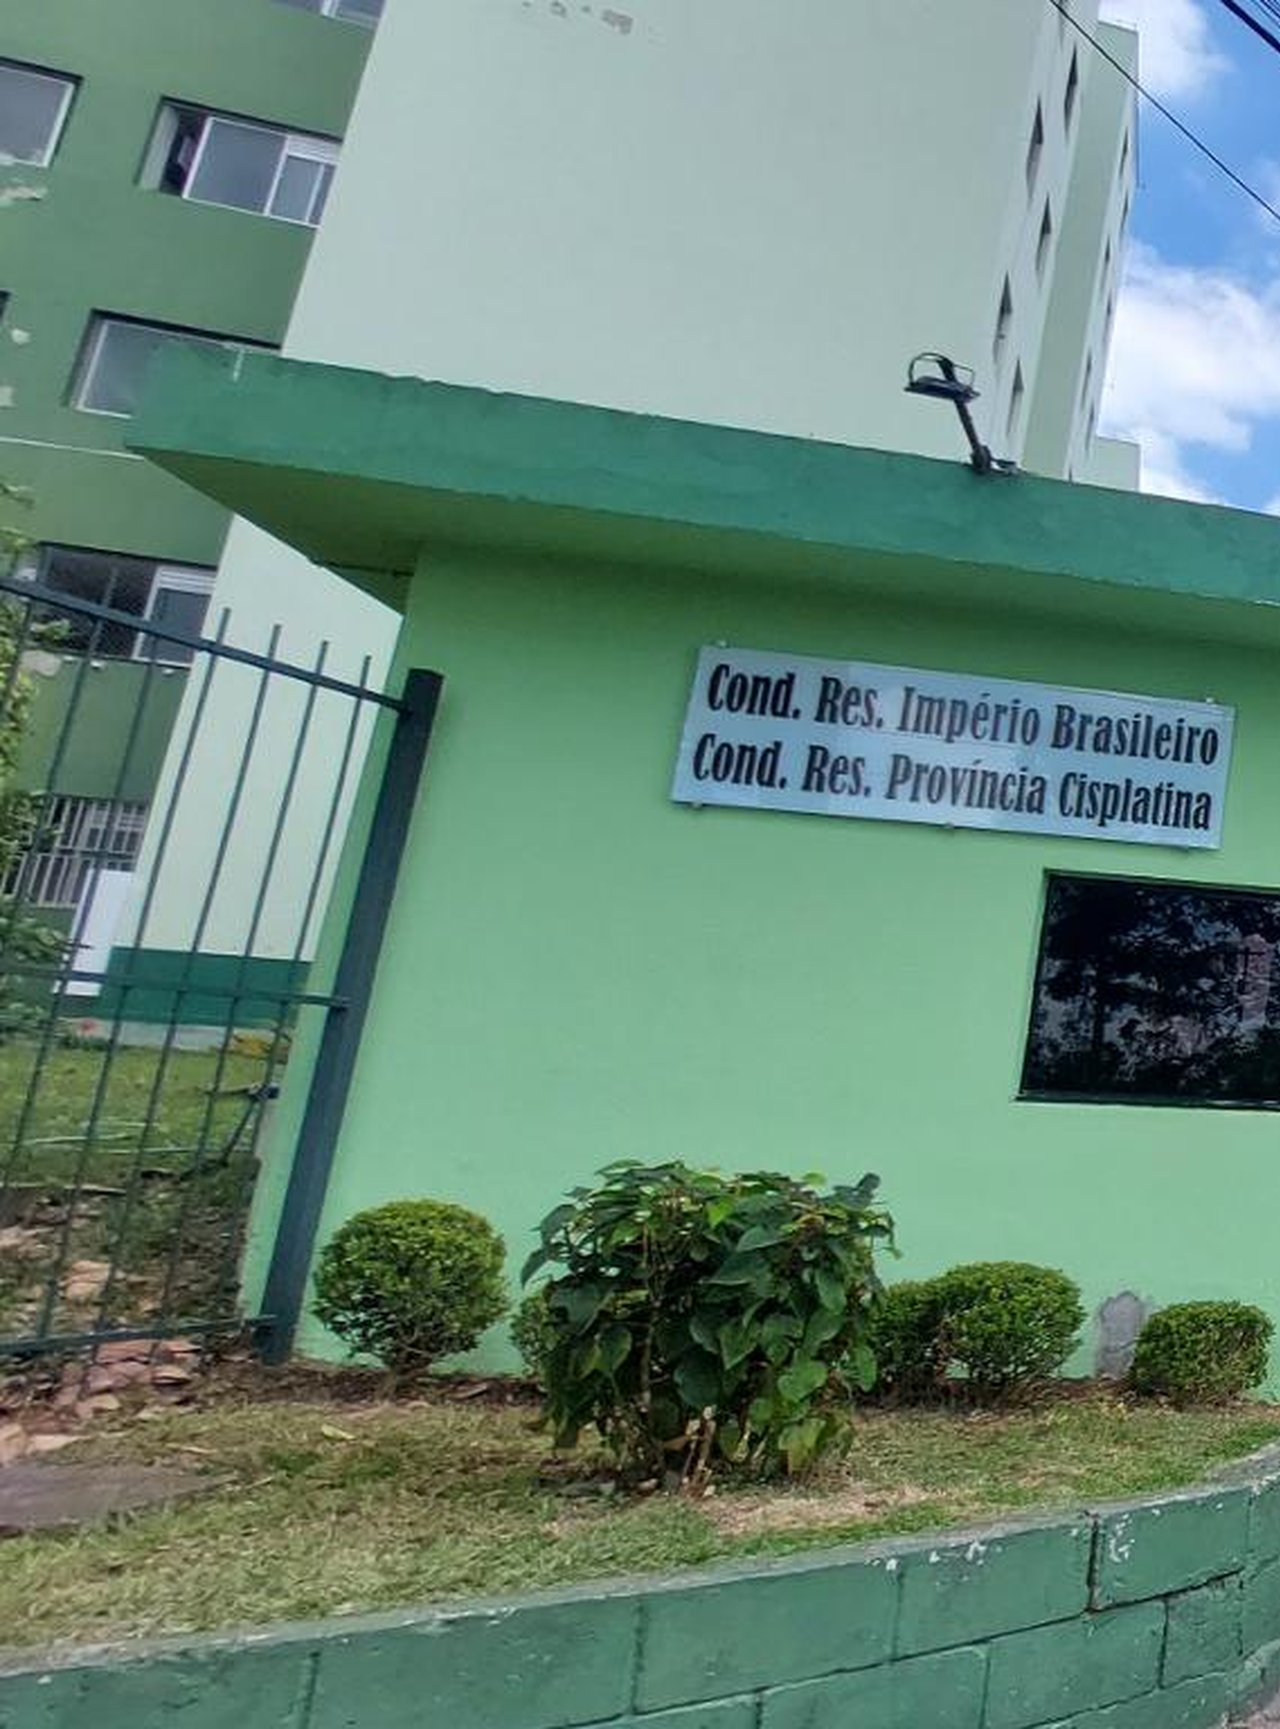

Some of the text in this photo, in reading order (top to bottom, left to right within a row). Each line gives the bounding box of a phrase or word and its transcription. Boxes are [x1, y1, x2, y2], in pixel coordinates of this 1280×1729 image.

[708, 664, 1218, 765] Cond. Res. Império Brasileiro
[693, 733, 1212, 831] Cond. Res. Província Cisplatina
